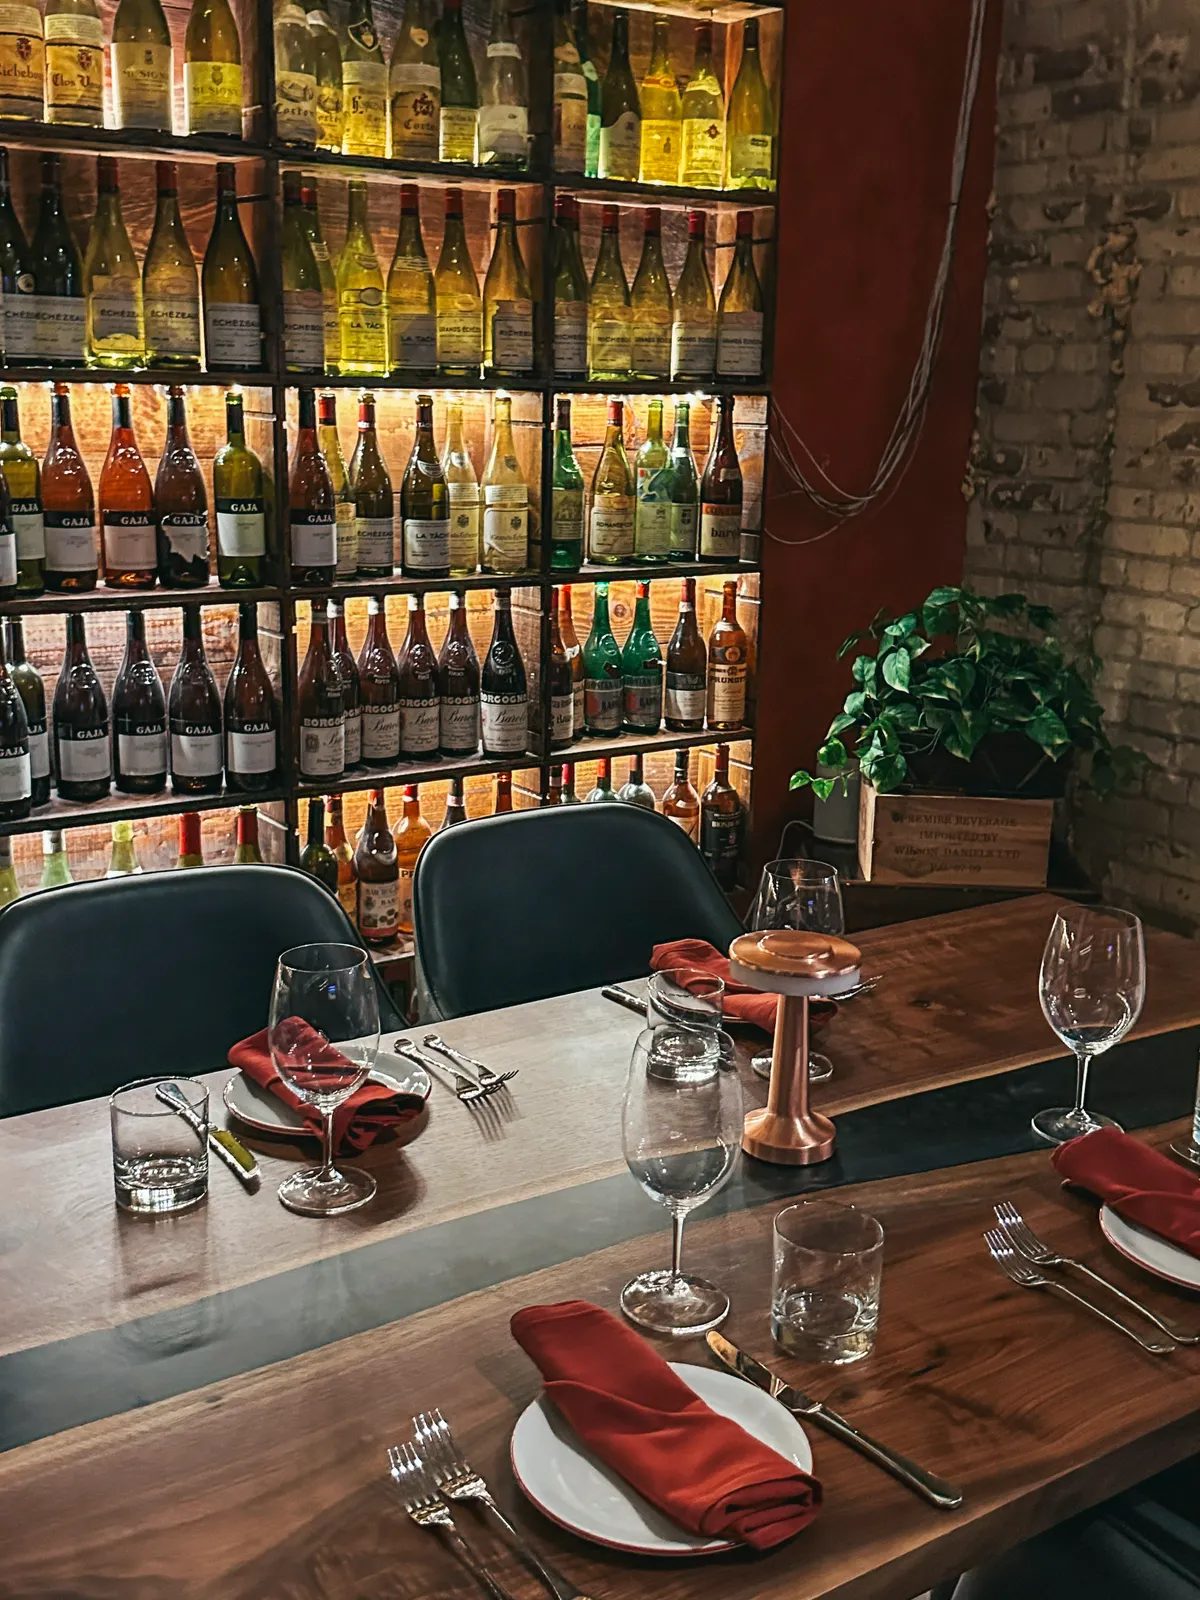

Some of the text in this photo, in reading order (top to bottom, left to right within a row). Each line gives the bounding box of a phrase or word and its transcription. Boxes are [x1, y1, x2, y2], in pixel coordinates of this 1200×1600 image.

[52, 73, 75, 87] Clos
[12, 503, 39, 513] GAJA
[231, 503, 258, 512] GAJA
[62, 517, 90, 526] GAJA
[121, 516, 149, 525] GAJA
[173, 516, 200, 525] GAJA
[308, 514, 333, 523] GAJA
[136, 724, 161, 735] GAJA
[186, 725, 213, 735] GAJA
[244, 723, 270, 733] GAJA
[77, 729, 104, 739] GAJA
[919, 830, 999, 843] IMPORTED BY
[944, 847, 993, 858] DANIELS
[997, 849, 1020, 860] LTD
